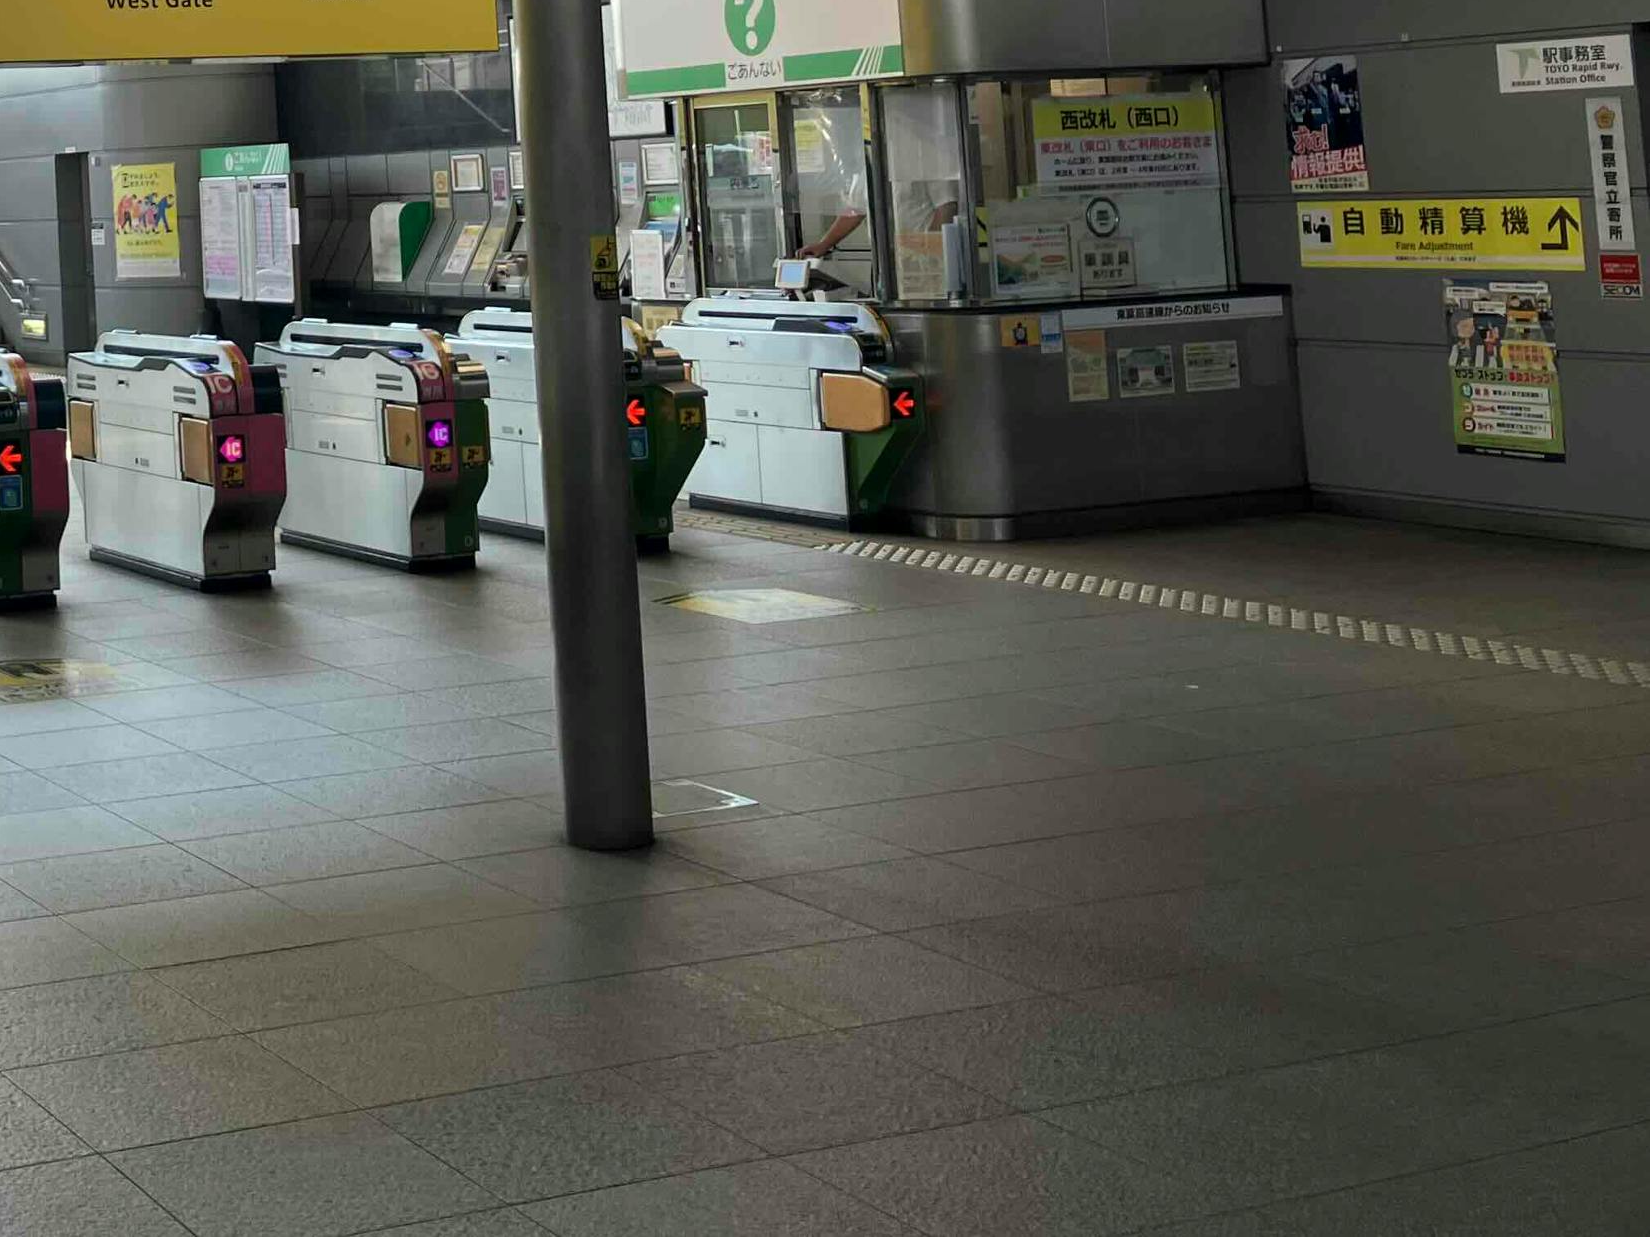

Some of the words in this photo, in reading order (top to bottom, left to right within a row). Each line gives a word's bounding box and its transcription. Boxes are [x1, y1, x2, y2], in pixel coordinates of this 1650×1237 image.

[1542, 45, 1606, 64] 駅事務室
[727, 61, 781, 80] ごあんない
[1545, 64, 1570, 74] TOYO
[1572, 62, 1598, 73] Rapid
[1545, 75, 1577, 86] Station
[1579, 73, 1606, 84] Office
[1600, 135, 1623, 241] 警察官立寄所
[1342, 206, 1530, 236] 自動精算機
[1418, 241, 1474, 252] Adjustment
[1603, 284, 1640, 295] SECOM
[206, 375, 233, 394] IC
[434, 427, 449, 441] IC
[226, 441, 241, 458] IC
